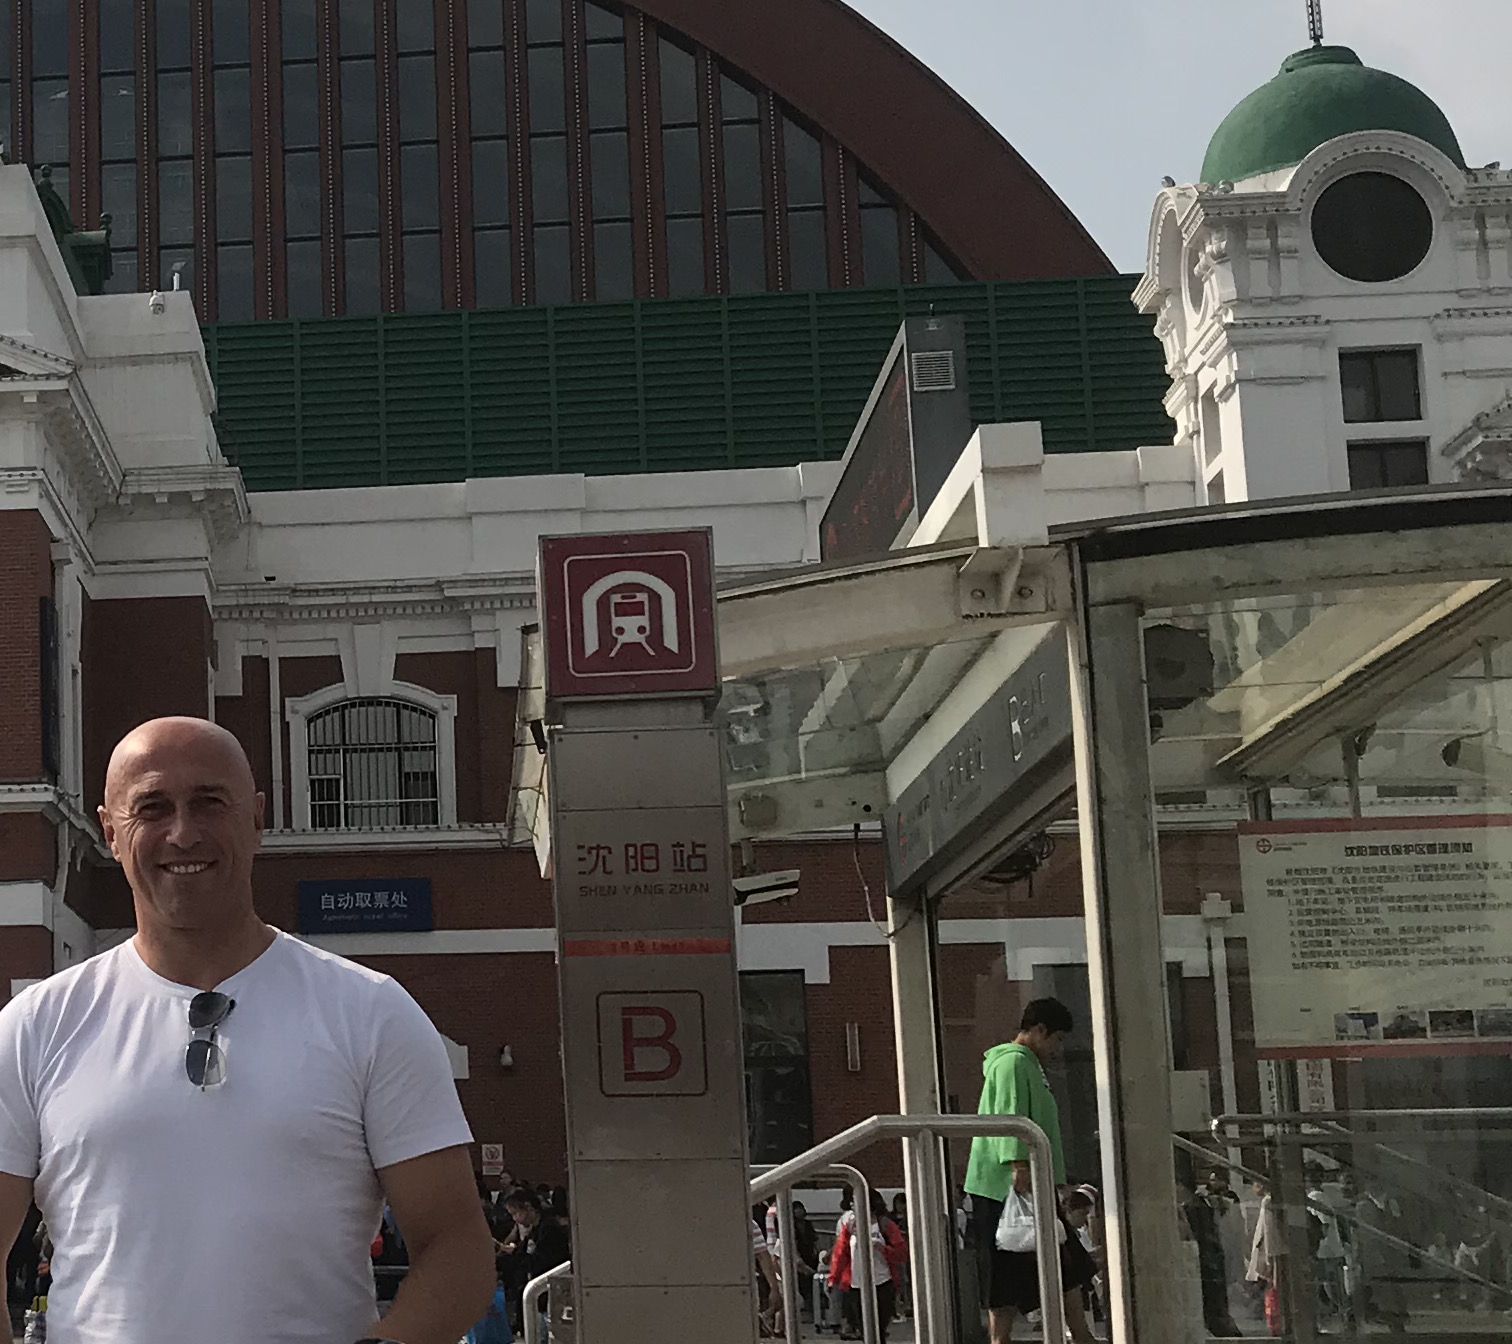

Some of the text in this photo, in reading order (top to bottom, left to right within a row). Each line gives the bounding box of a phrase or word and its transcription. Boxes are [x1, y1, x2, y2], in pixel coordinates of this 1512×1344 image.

[576, 841, 708, 875] 沈阳站
[320, 891, 408, 910] 自动取票处
[579, 882, 710, 897] SHEN YANG ZHAN
[620, 1005, 682, 1083] B
